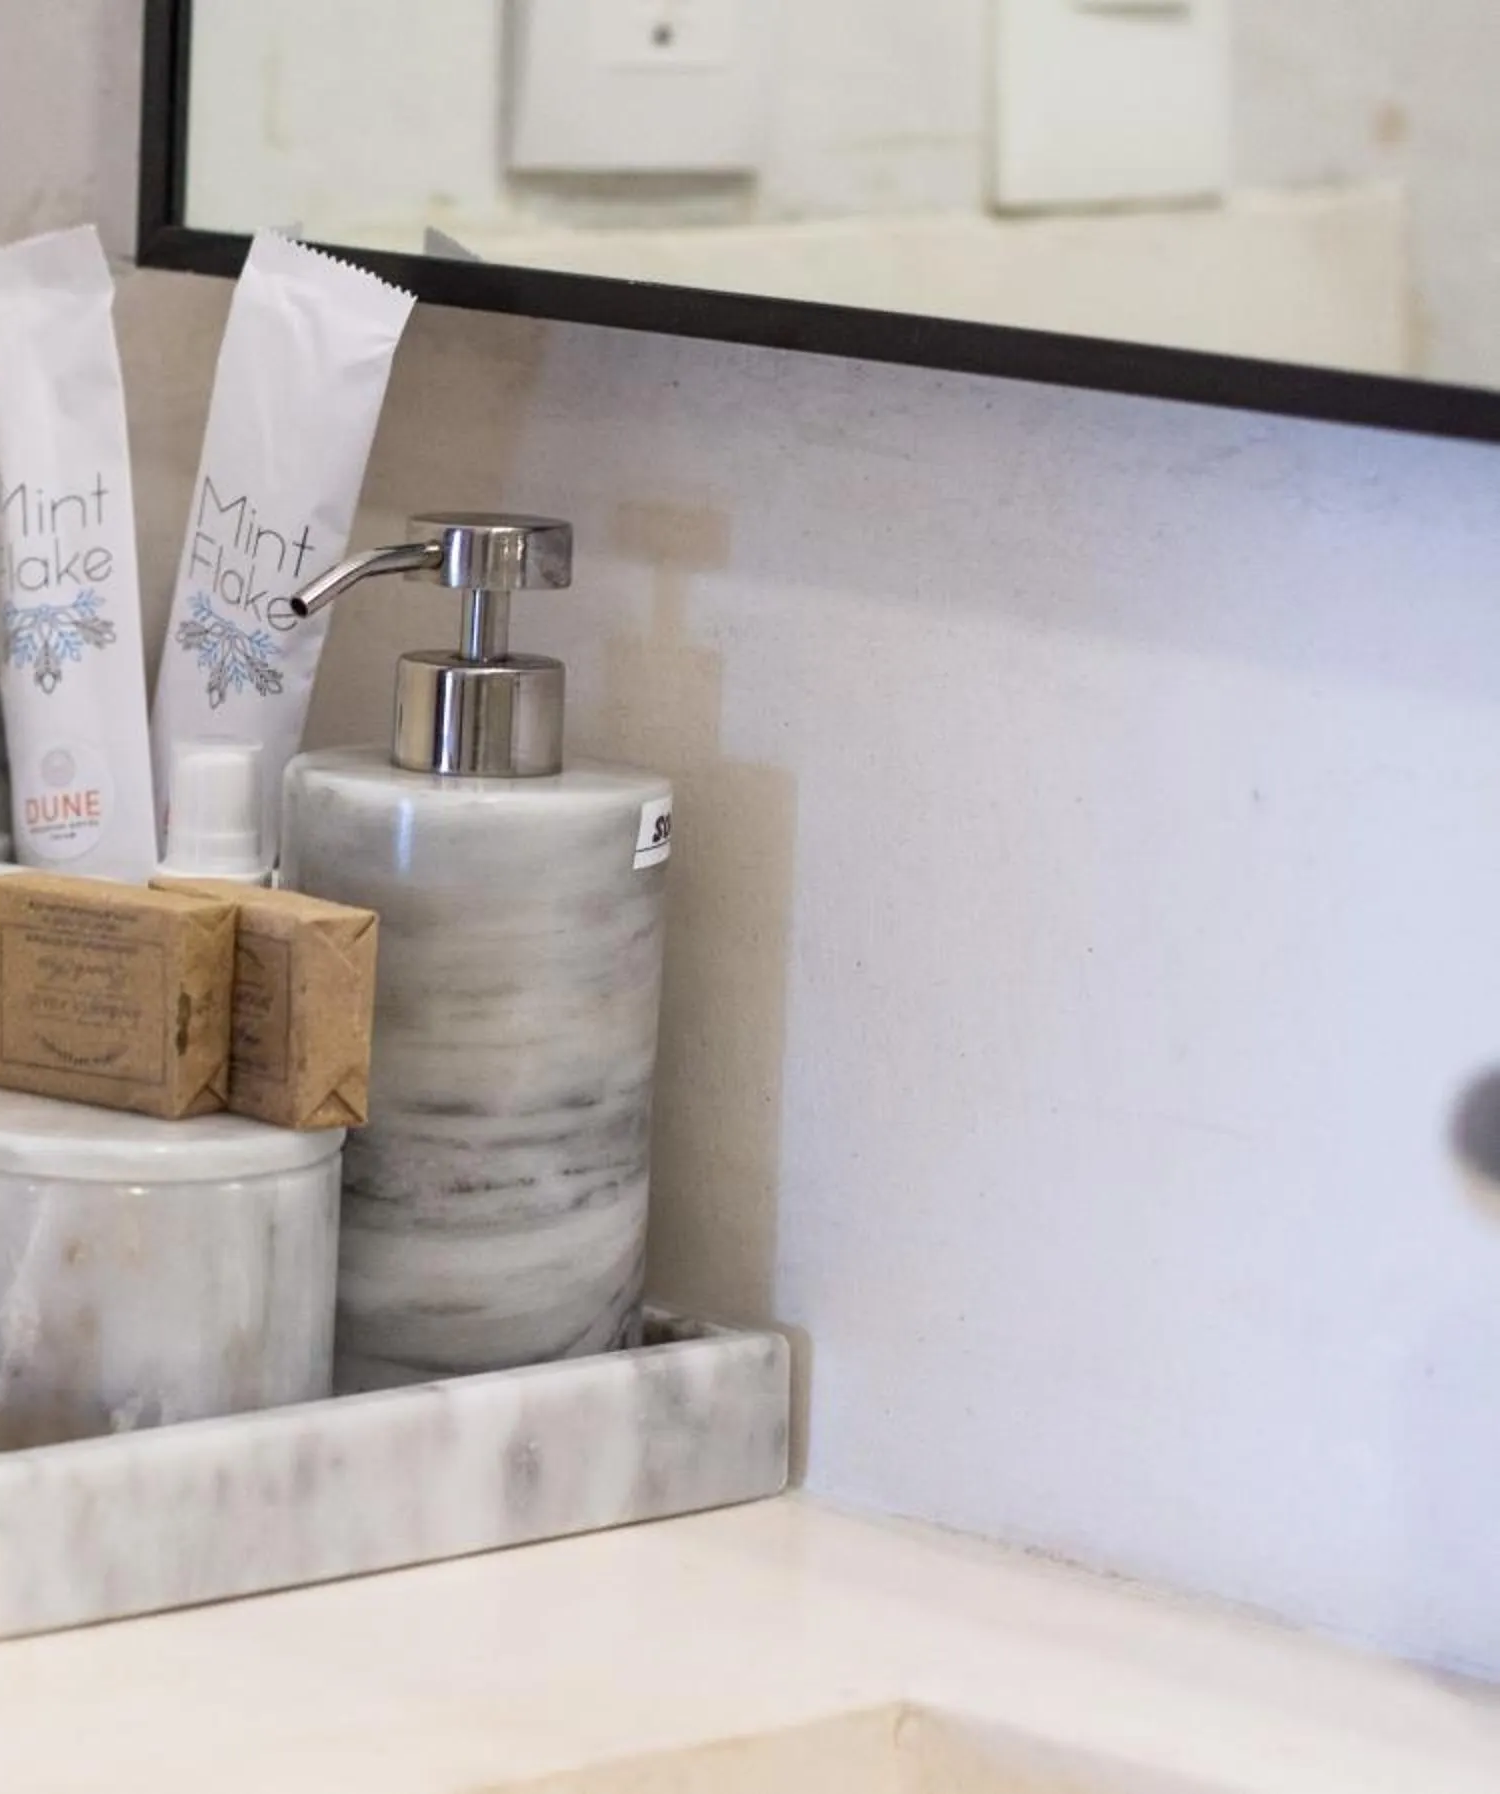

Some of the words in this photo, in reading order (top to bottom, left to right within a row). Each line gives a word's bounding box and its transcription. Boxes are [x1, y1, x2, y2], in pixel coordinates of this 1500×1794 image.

[198, 476, 316, 578] Mint
[189, 531, 298, 631] Flake
[24, 789, 102, 825] DUNE
